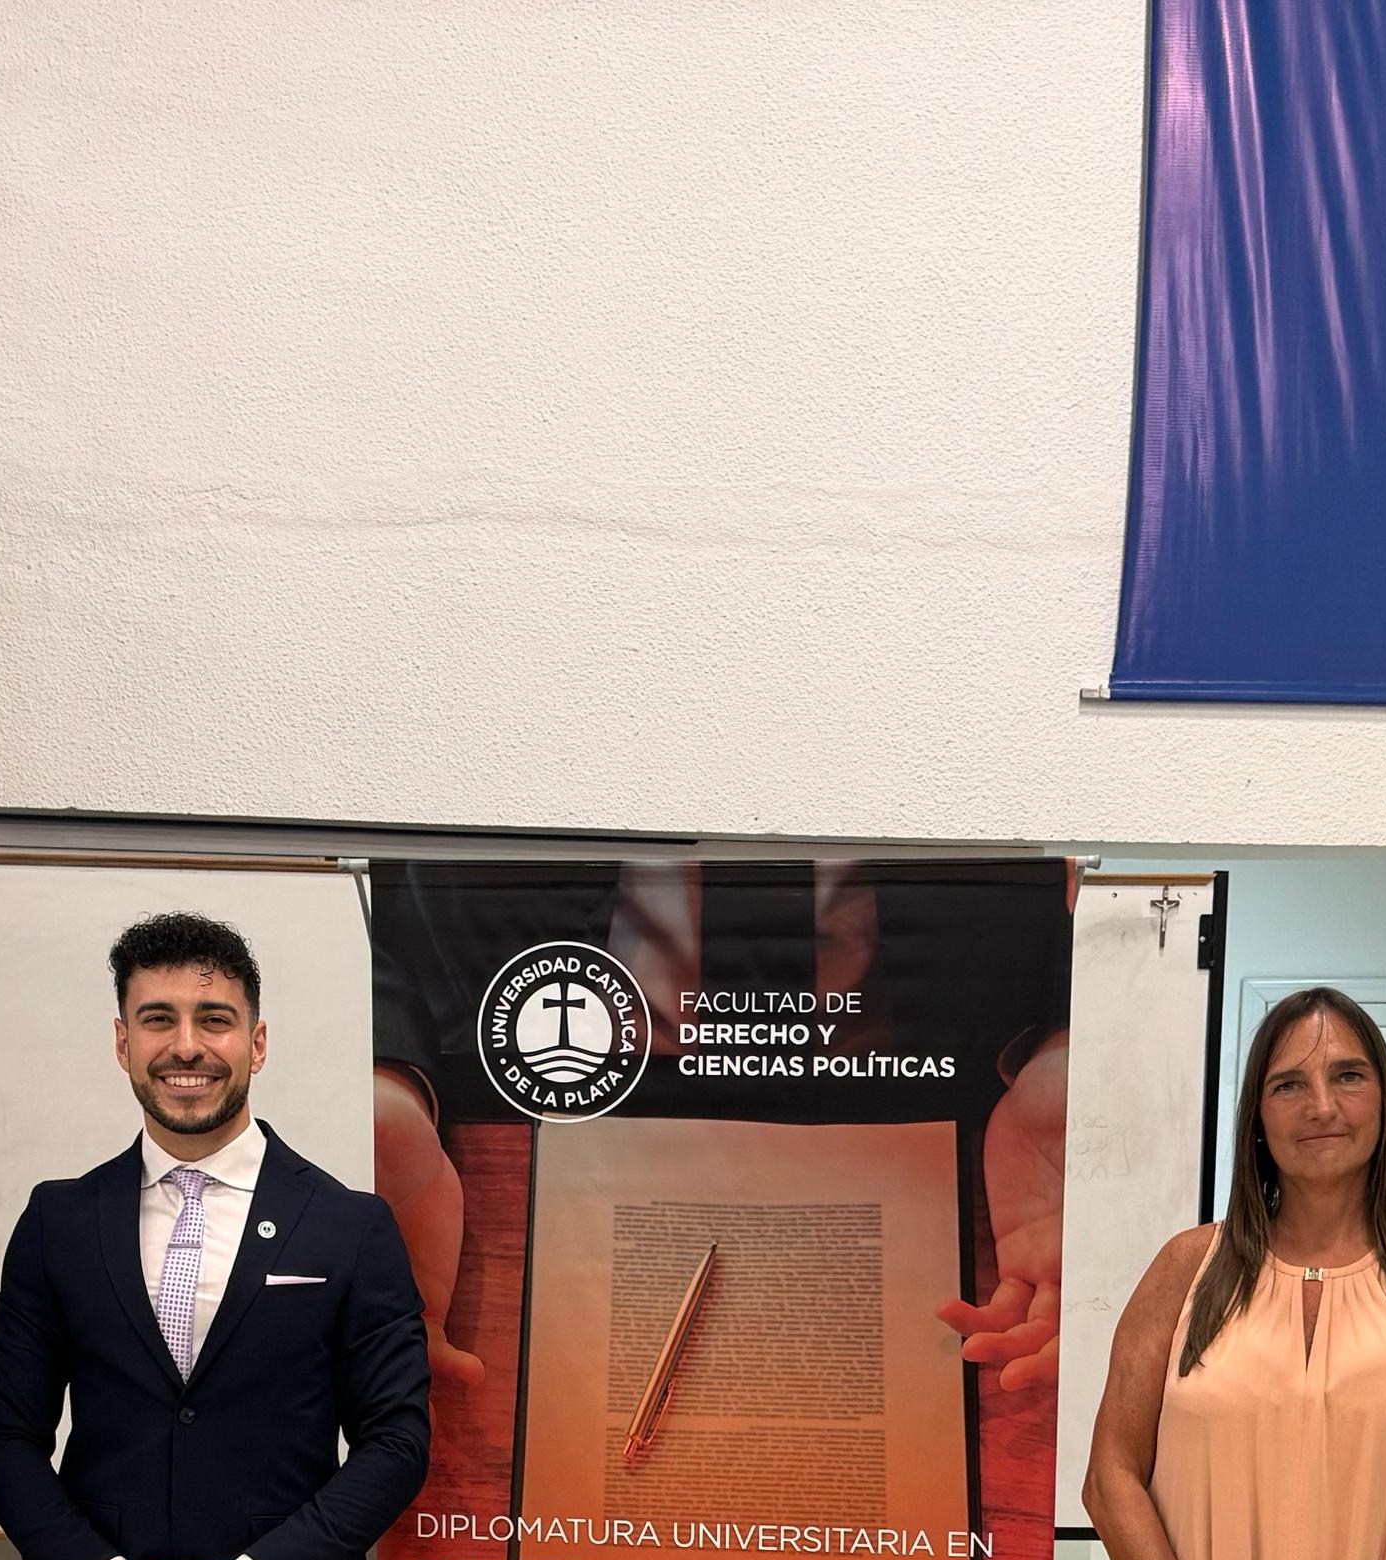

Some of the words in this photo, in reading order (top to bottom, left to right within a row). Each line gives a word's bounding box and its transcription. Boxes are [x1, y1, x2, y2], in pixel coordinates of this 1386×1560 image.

[491, 956, 581, 1048] UNIVERSIDAD
[585, 963, 637, 1053] CATÓLICA
[679, 991, 817, 1013] FACULTAD
[826, 992, 862, 1013] DE
[679, 1023, 810, 1045] DERECHO
[817, 1024, 836, 1045] Y
[678, 1054, 805, 1077] CIENCIAS
[813, 1050, 956, 1078] POLÍTICAS
[504, 1065, 532, 1094] DE
[531, 1085, 558, 1107] LA
[564, 1069, 624, 1108] PLATA
[417, 1513, 661, 1547] DIPLOMATURA
[673, 1521, 934, 1556] UNIVERSITARIA
[947, 1531, 994, 1558] EN
